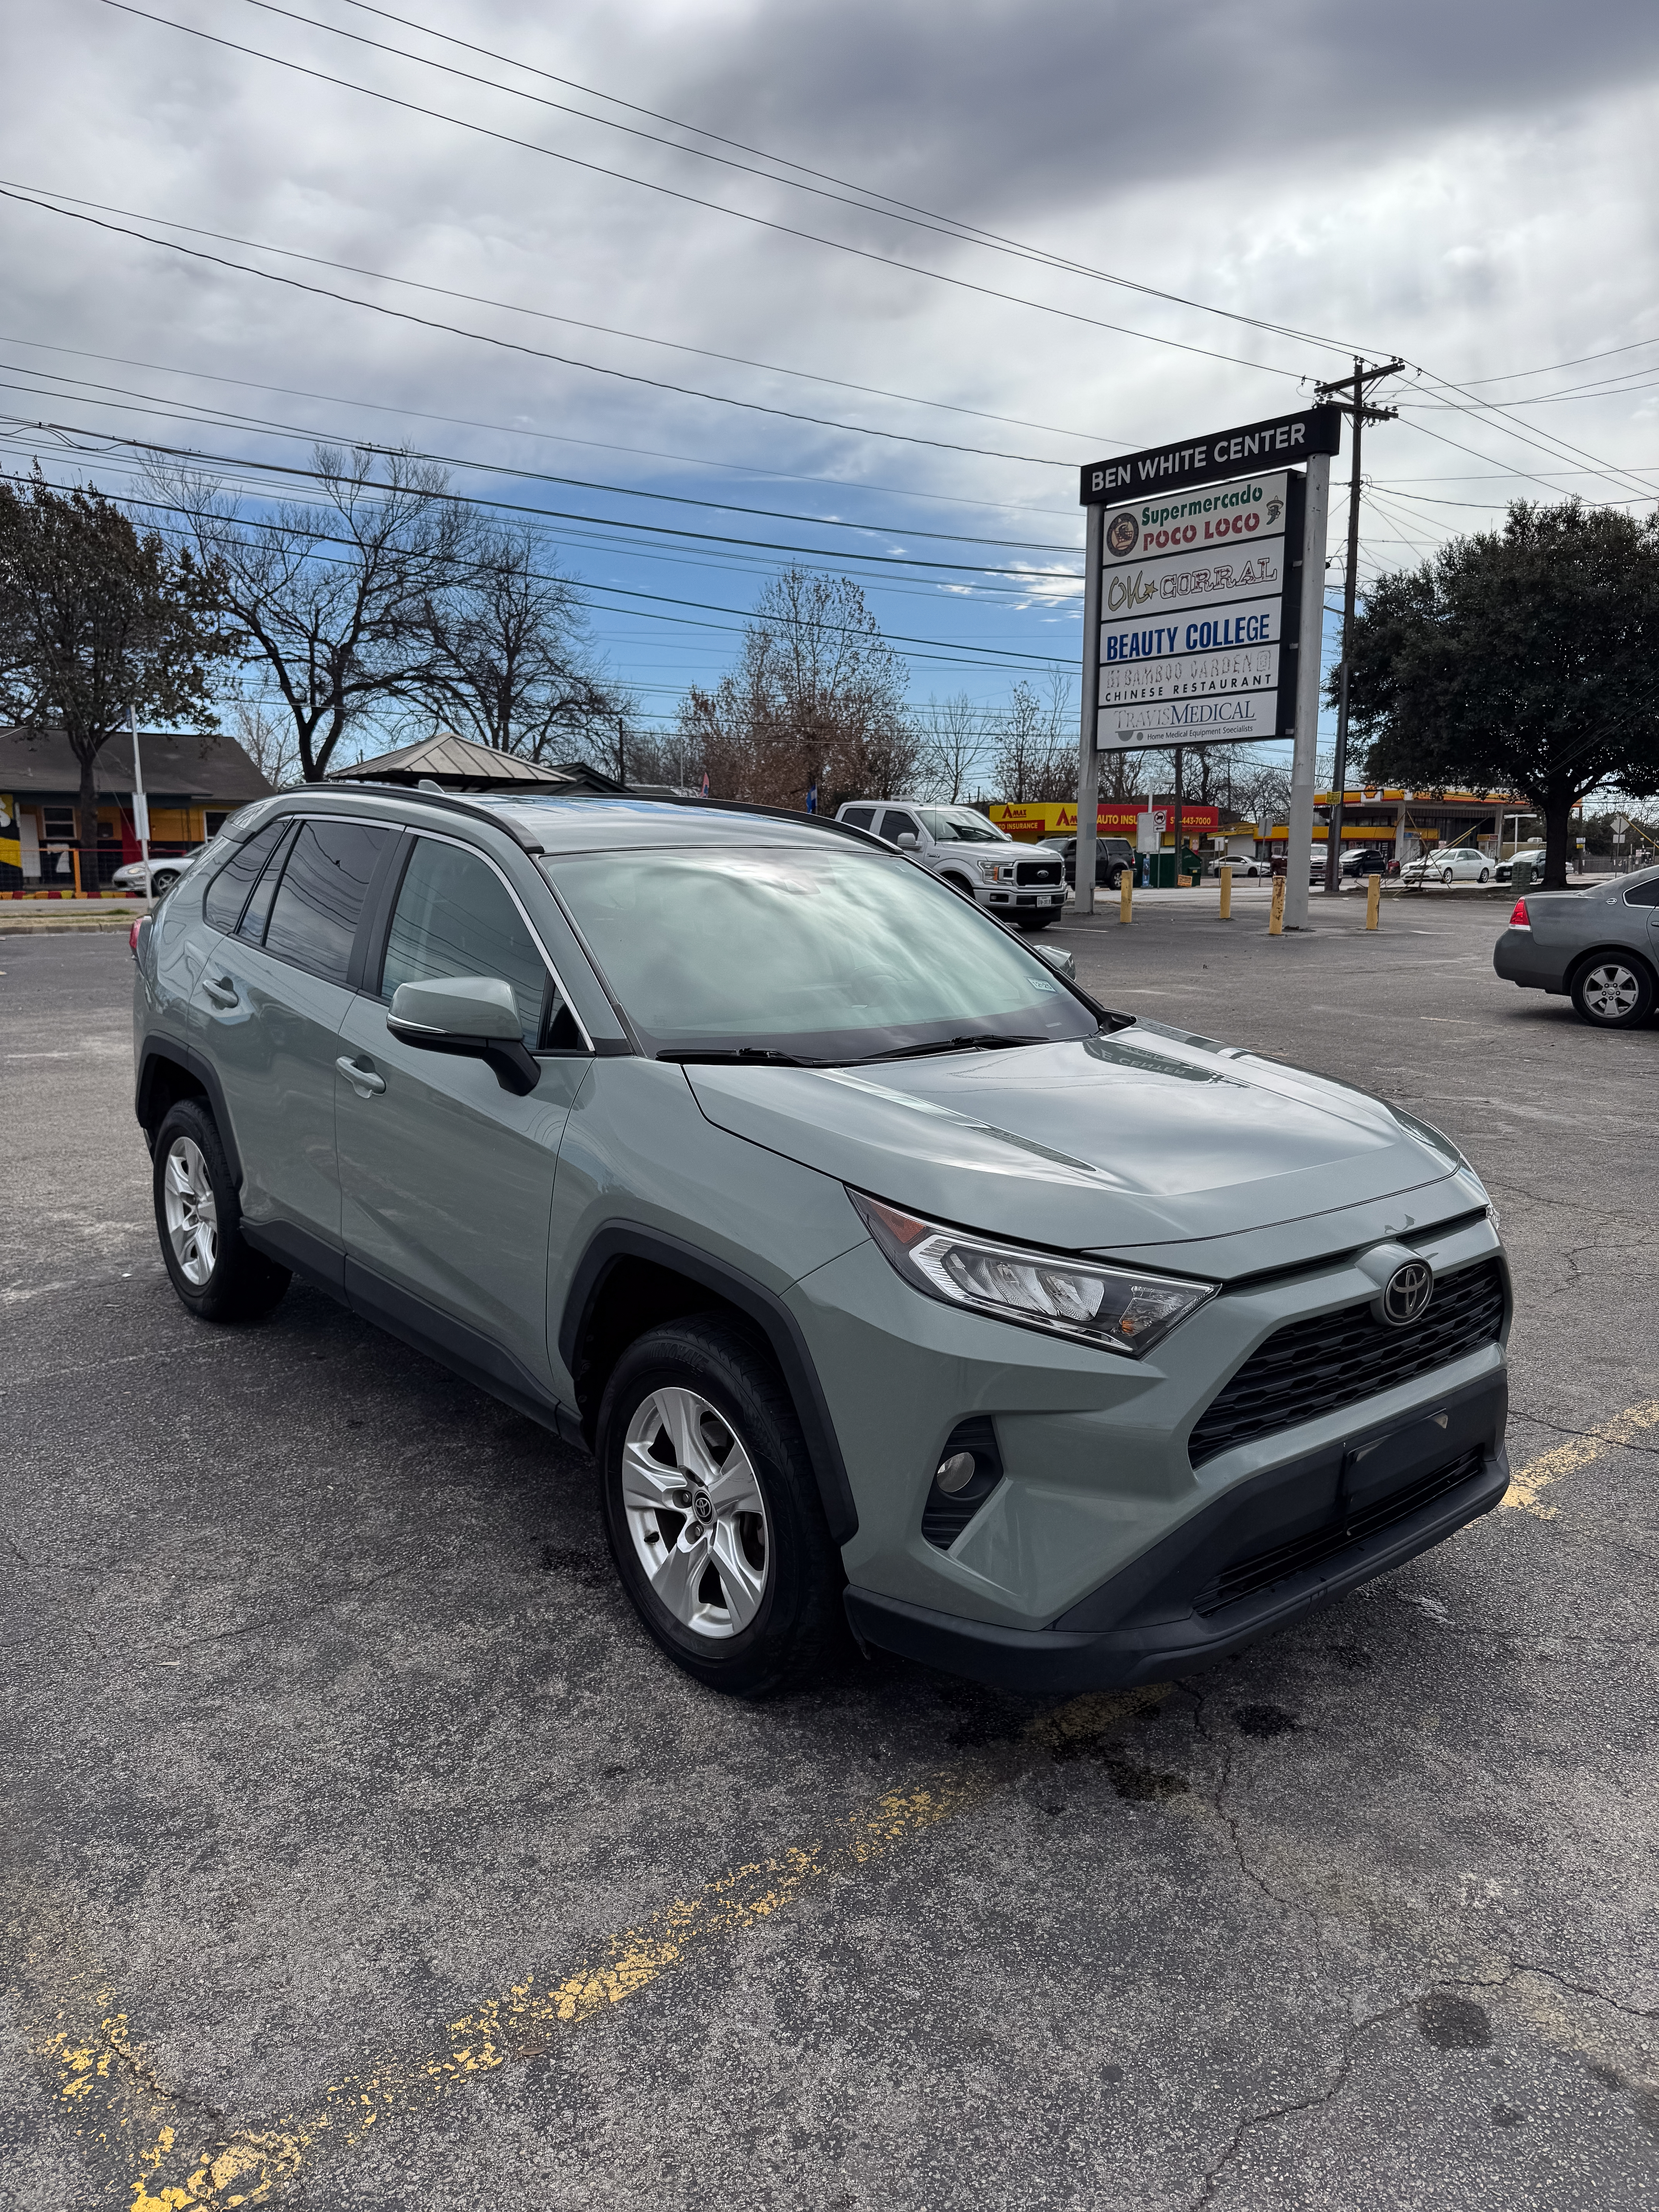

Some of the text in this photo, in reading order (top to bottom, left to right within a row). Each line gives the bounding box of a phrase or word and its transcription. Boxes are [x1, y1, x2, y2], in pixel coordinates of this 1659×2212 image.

[1092, 423, 1305, 491] BEN WHITE CENTER
[1141, 484, 1263, 527] Supermercado
[1143, 524, 1197, 551] POCO
[1204, 513, 1260, 540] LOCO
[1159, 557, 1277, 599] CORRAL
[1107, 613, 1270, 661] BEAUTY COLLEGE
[1105, 674, 1272, 702] CHINESE RESTAURANT
[1124, 661, 1183, 687] BAMBOO
[1165, 730, 1188, 739] Medical
[1189, 727, 1221, 738] Equipment
[1097, 814, 1118, 824] AUTO
